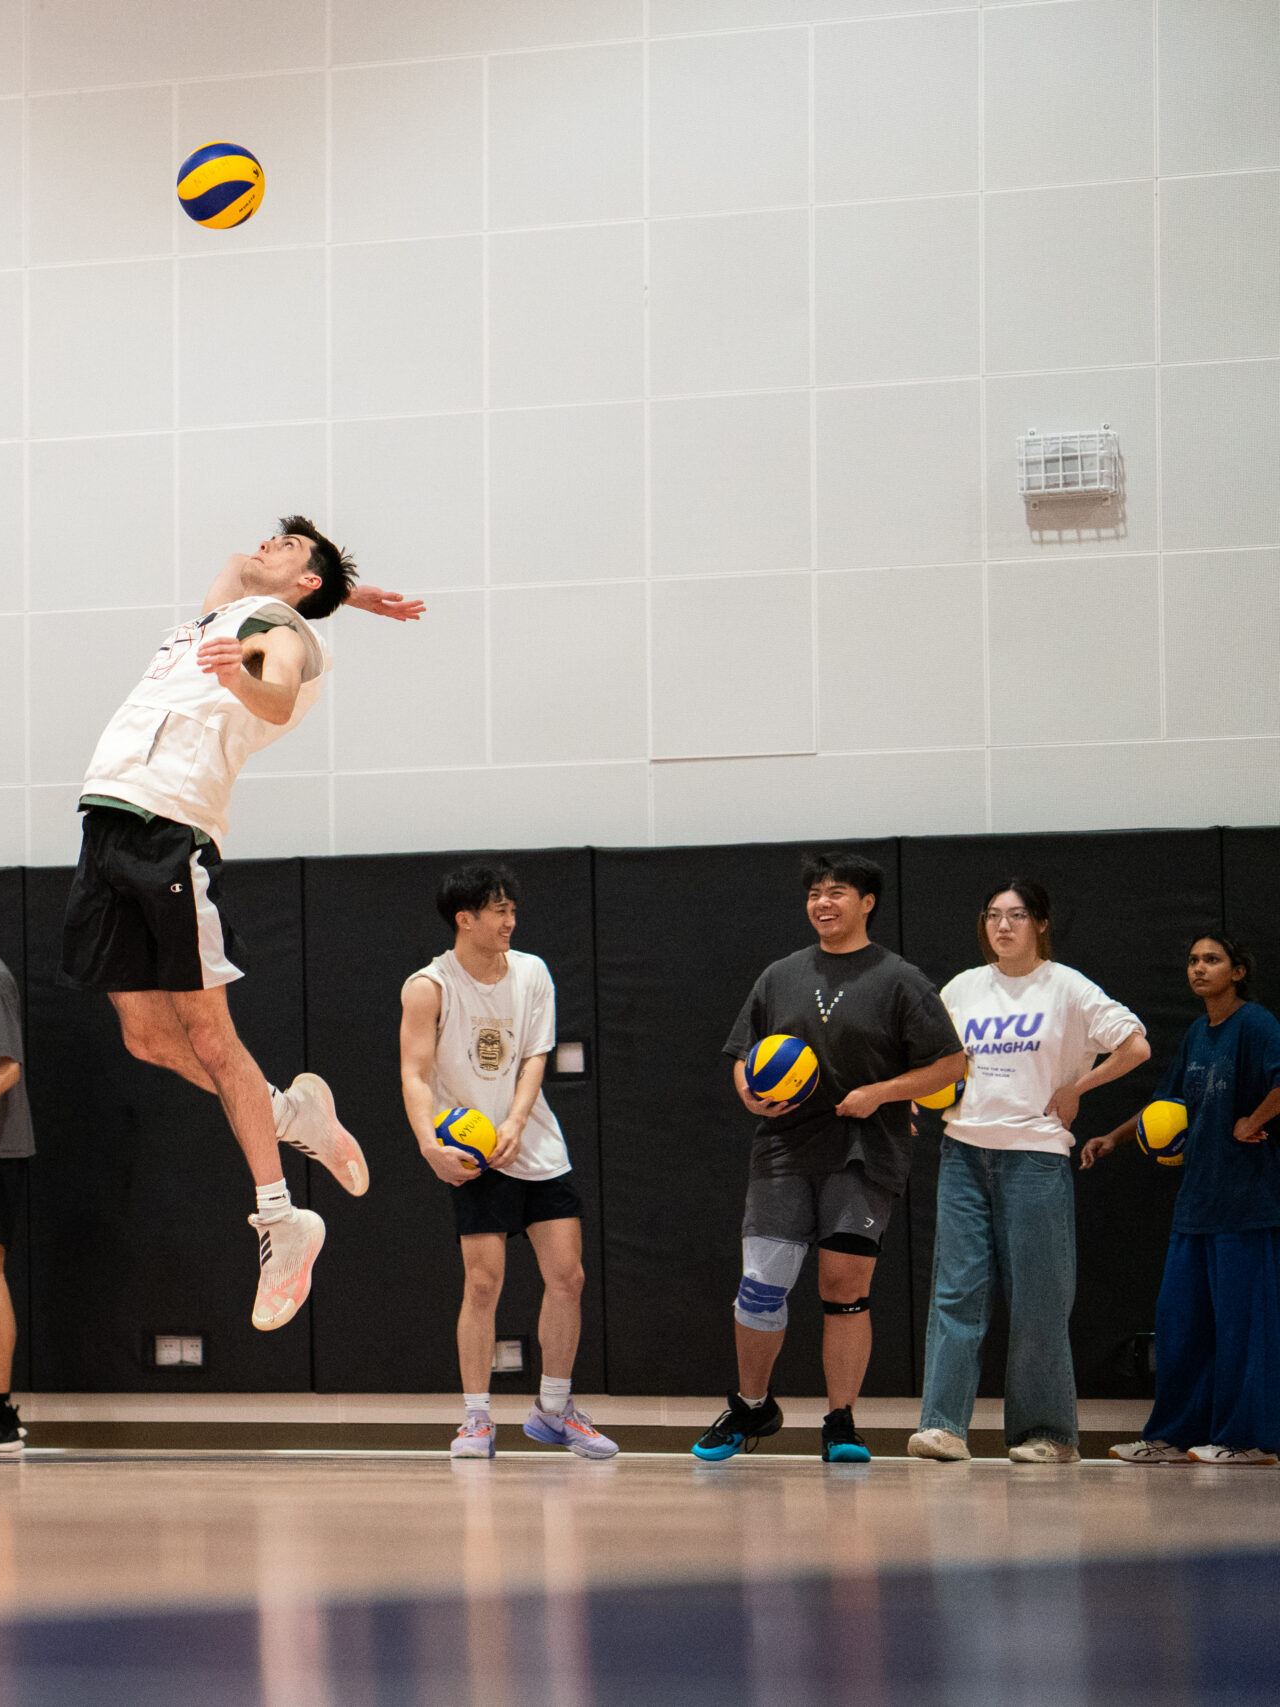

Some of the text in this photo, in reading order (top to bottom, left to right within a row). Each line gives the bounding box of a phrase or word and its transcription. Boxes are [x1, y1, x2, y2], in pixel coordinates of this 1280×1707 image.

[964, 1012, 1044, 1044] NYU
[966, 1040, 1041, 1057] SHANGHAI
[458, 1114, 483, 1142] NYUSH
